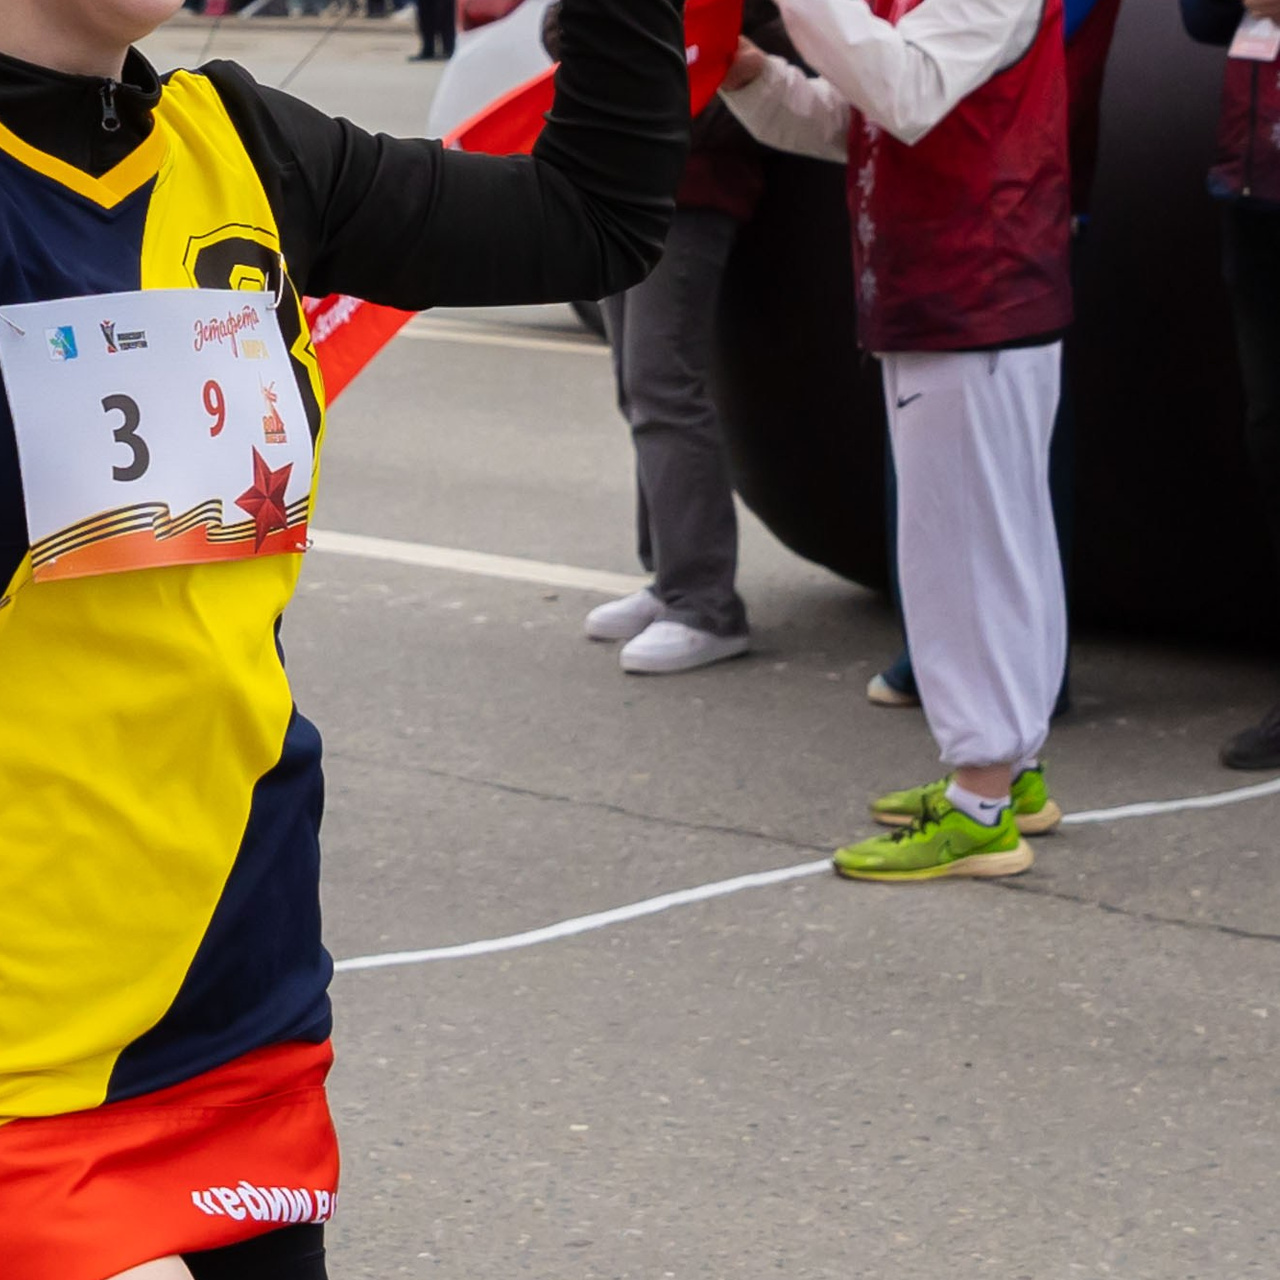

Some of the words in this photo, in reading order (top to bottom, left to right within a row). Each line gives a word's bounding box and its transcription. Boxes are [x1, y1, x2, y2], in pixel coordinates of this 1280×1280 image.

[193, 305, 260, 358] Эстафета
[202, 379, 226, 437] 9
[101, 393, 150, 482] 3
